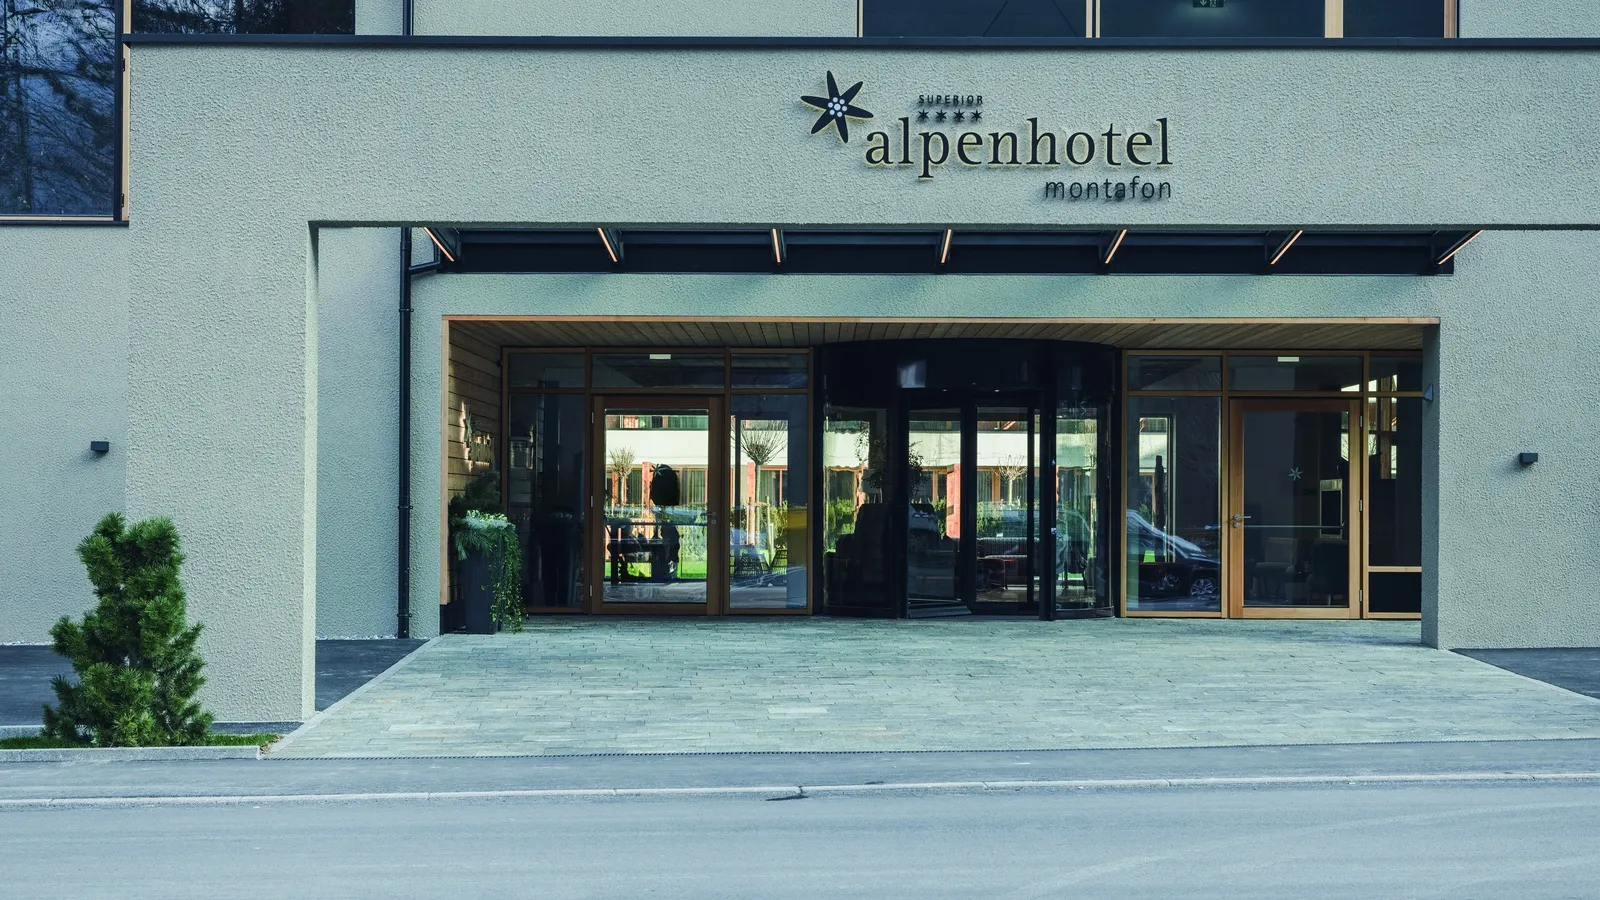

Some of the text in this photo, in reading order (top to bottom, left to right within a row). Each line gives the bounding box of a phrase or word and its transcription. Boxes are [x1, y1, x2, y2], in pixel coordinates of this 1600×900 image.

[918, 94, 984, 105] SUPERIOR
[865, 117, 1173, 179] alpenhotel
[1045, 176, 1172, 199] montafon
